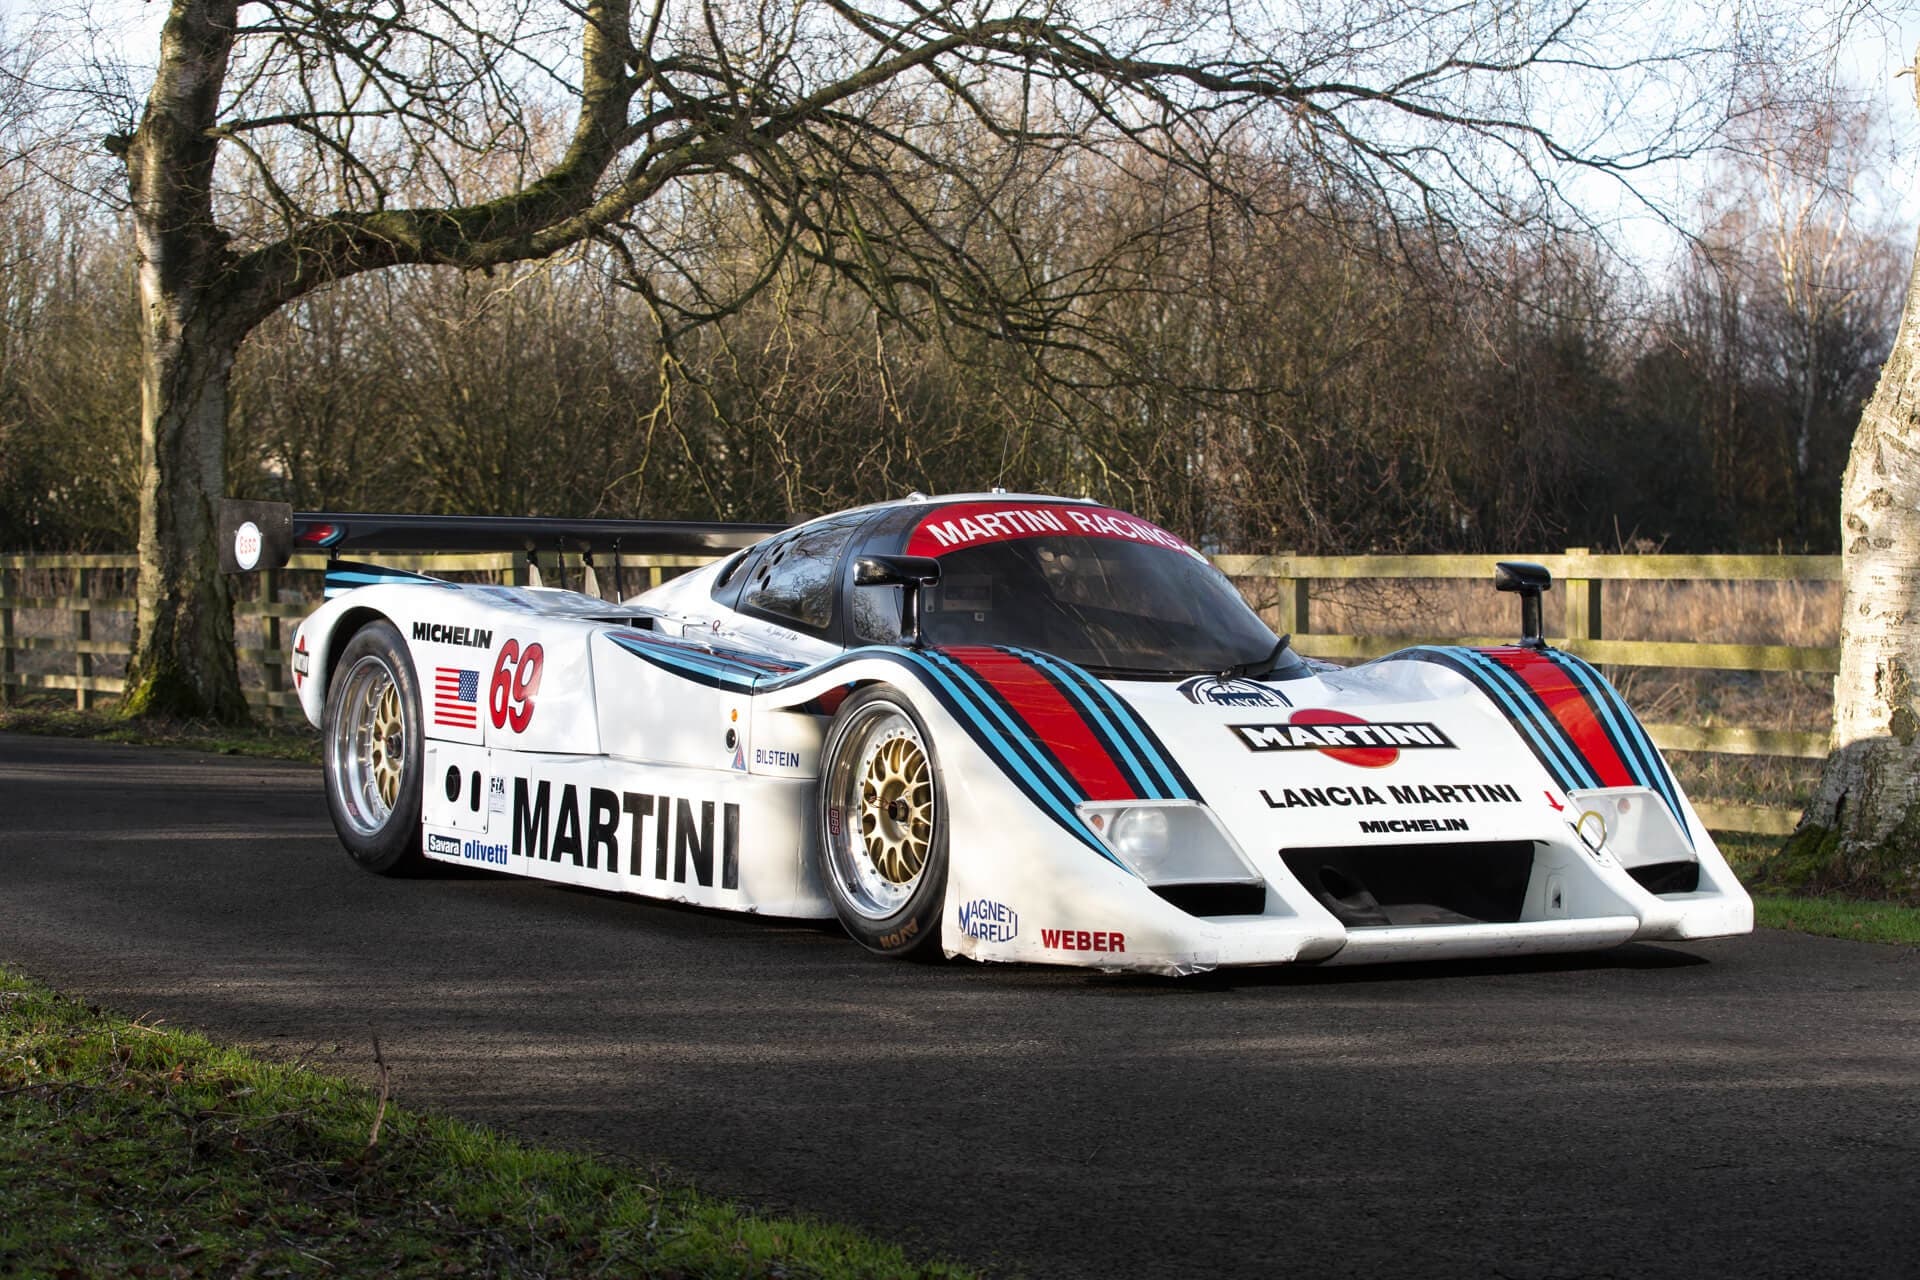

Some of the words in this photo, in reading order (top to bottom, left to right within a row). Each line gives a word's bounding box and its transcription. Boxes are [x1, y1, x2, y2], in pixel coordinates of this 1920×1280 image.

[926, 510, 1068, 547] MARTINI
[1066, 511, 1180, 549] RACING
[413, 621, 493, 649] MICHELIN
[489, 638, 544, 734] 69
[1240, 725, 1445, 748] MARTINI
[756, 749, 800, 768] BILSTEIN
[1259, 786, 1387, 808] LANCIA
[1386, 784, 1522, 804] MARTINI
[512, 776, 740, 890] MARTINI
[1358, 818, 1469, 833] MICHELIN
[429, 835, 460, 855] Savara
[464, 839, 508, 865] olivetti
[1041, 928, 1125, 953] WEBER
